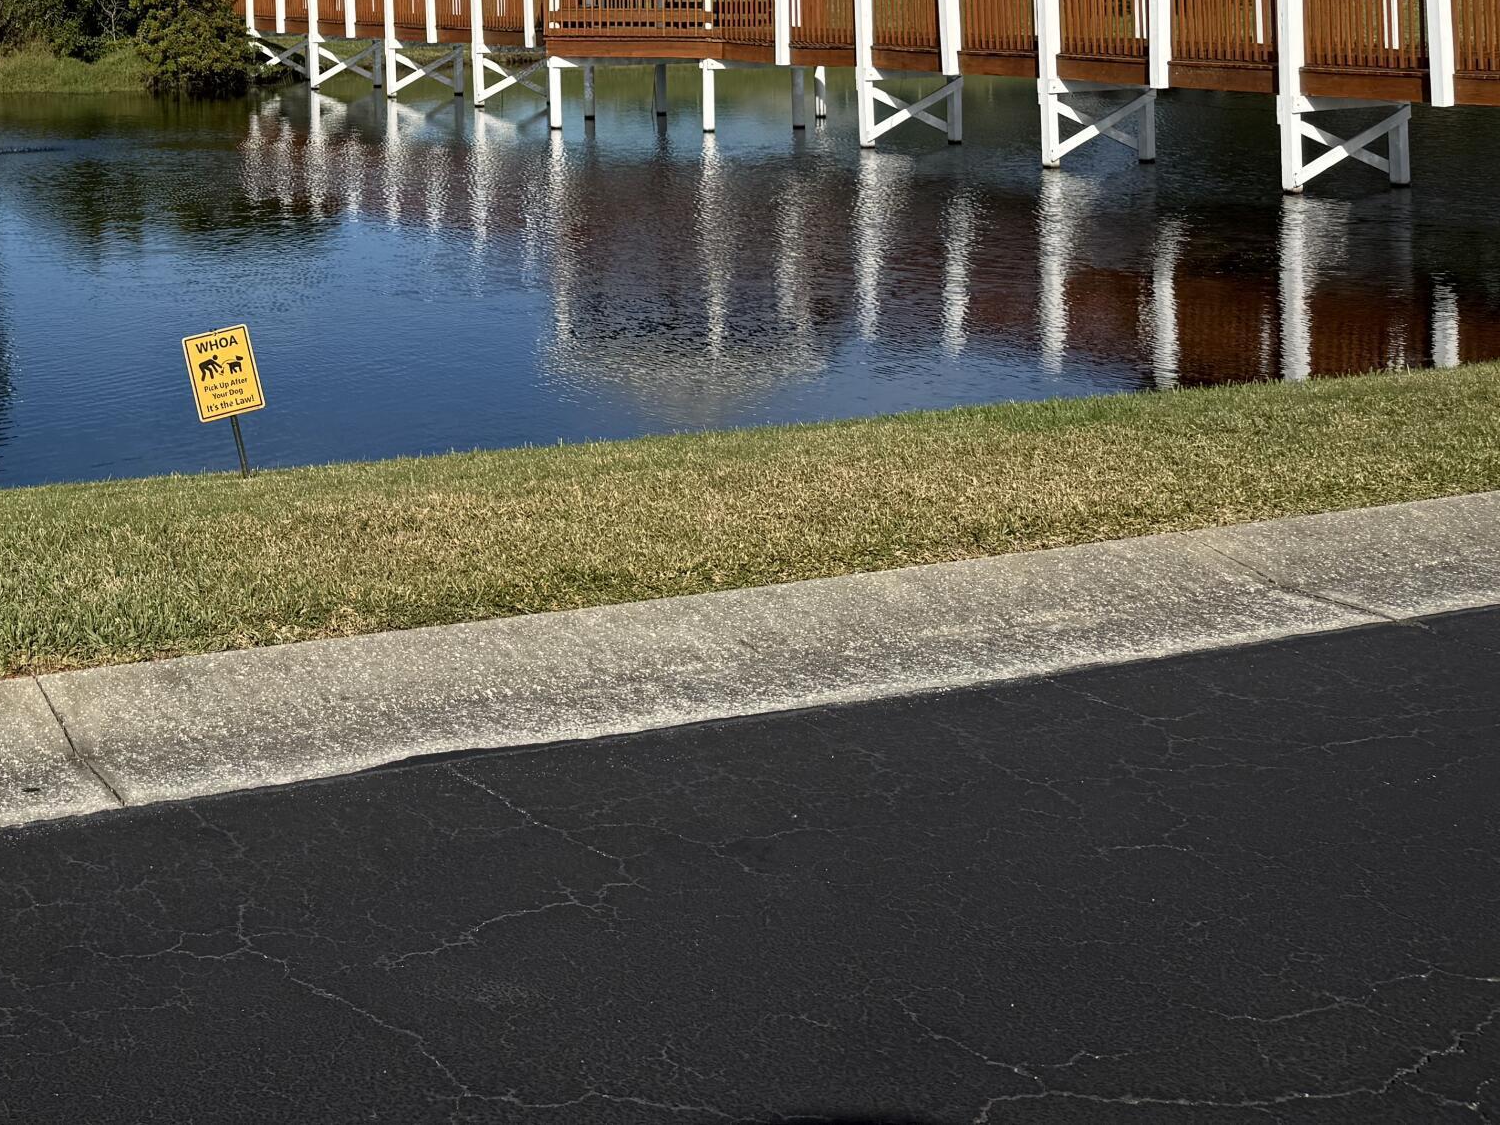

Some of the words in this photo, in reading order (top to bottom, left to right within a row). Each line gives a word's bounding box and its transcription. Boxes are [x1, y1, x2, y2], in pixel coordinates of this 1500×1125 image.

[195, 335, 238, 354] WHOA
[204, 385, 219, 393] Pick
[220, 381, 230, 389] Up
[230, 377, 247, 386] After
[212, 391, 228, 399] Your
[206, 404, 219, 413] It's
[220, 400, 234, 408] the
[235, 395, 255, 405] Law!
